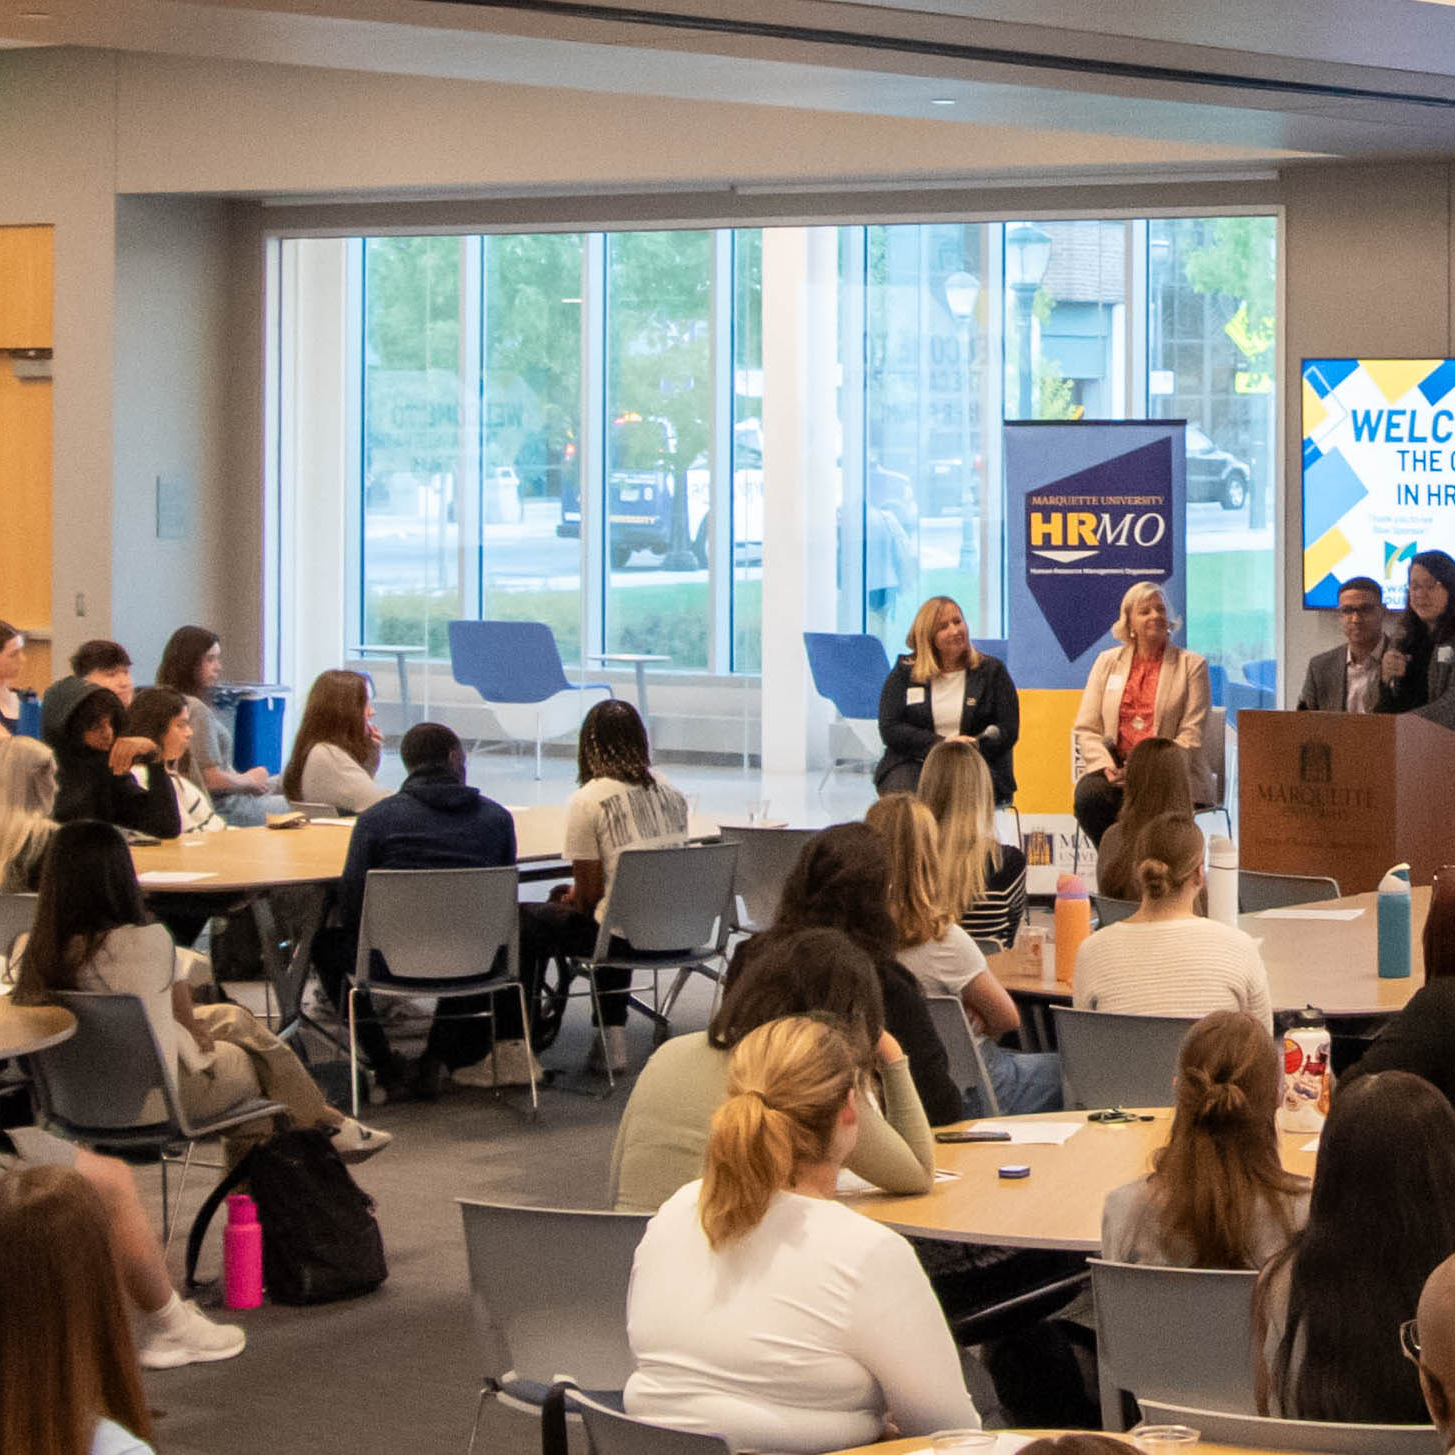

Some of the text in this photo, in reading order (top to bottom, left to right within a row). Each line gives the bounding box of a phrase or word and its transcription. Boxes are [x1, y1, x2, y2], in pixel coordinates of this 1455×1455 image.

[1397, 449, 1443, 473] THE
[1031, 495, 1165, 506] MARQUETTE UNIVERSITY
[1397, 483, 1419, 506] IN
[1030, 511, 1166, 547] HRMO
